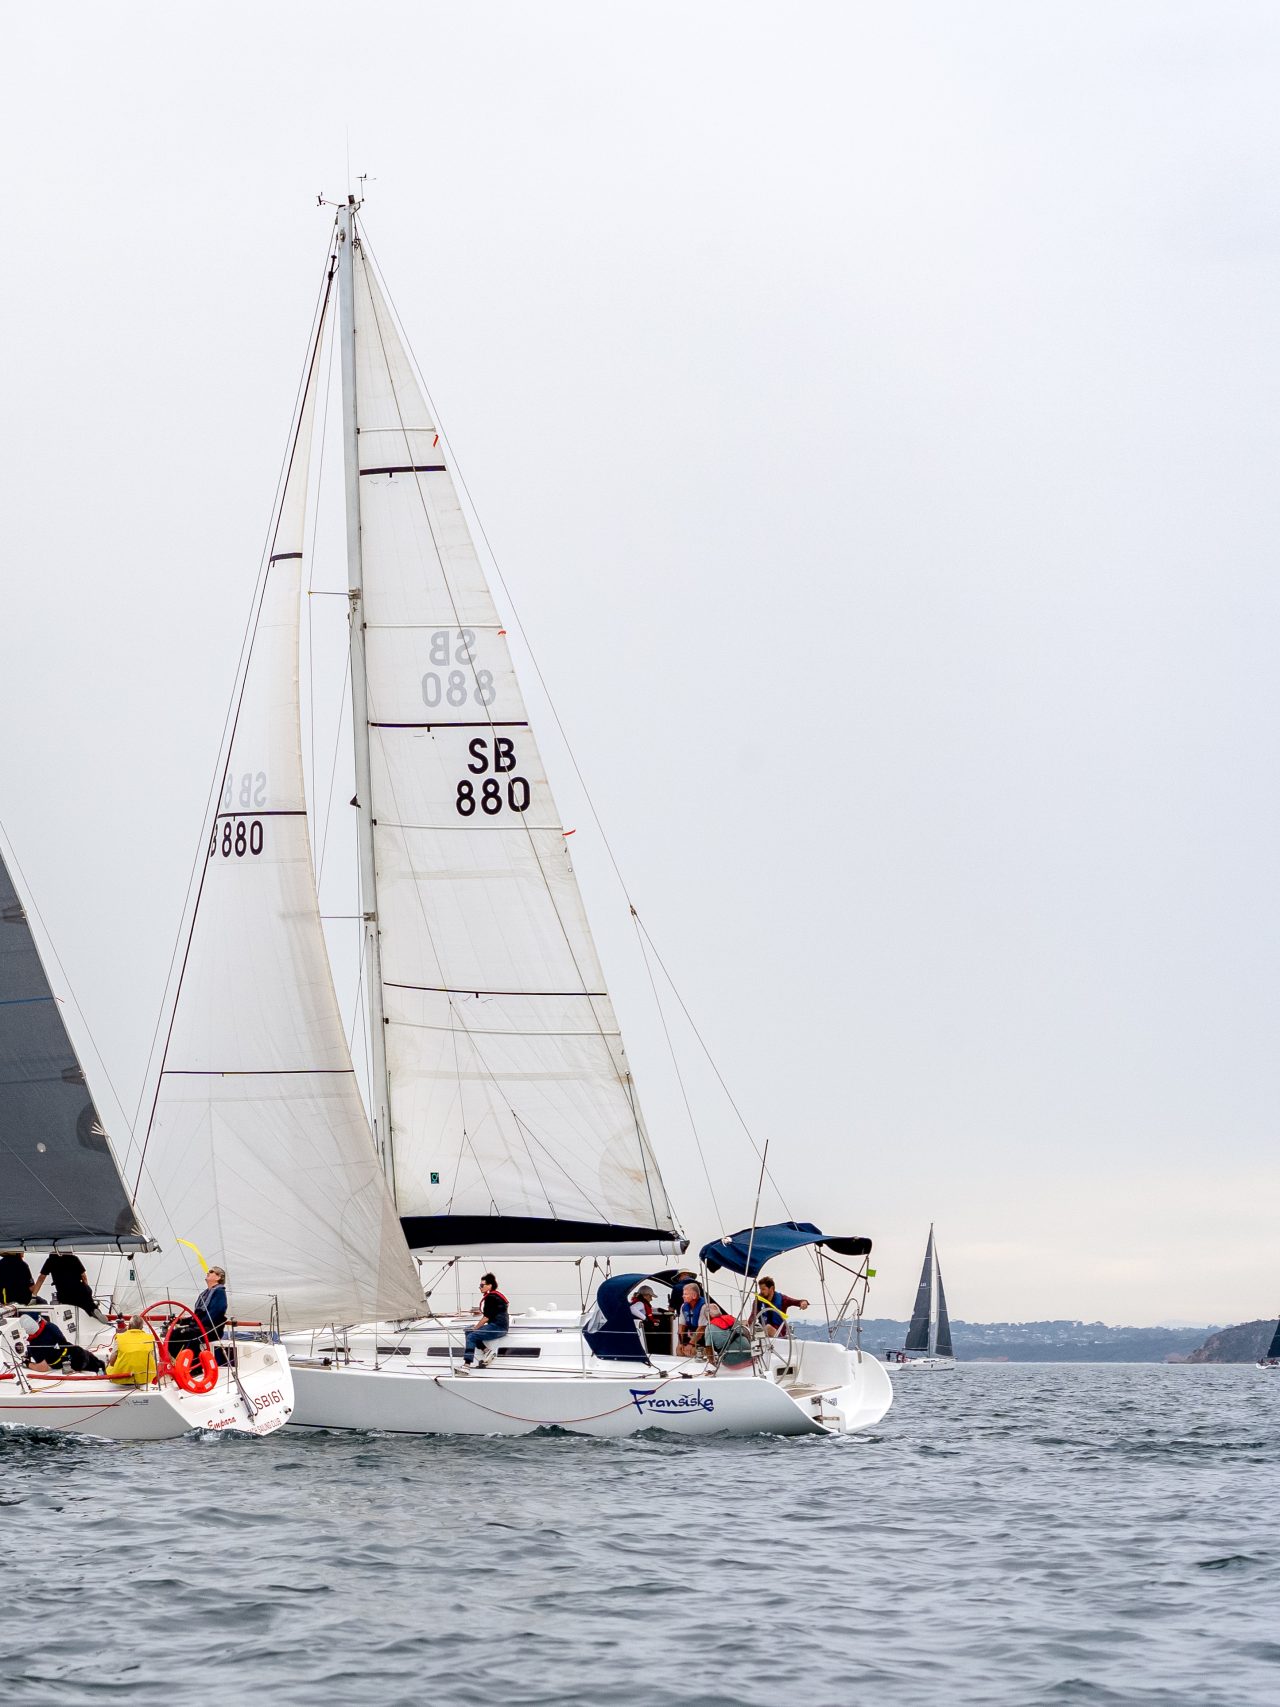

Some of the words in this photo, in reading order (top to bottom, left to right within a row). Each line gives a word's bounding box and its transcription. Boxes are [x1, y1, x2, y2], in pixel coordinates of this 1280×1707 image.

[467, 737, 517, 775] SB
[456, 776, 531, 817] 880
[254, 1389, 284, 1410] SB161
